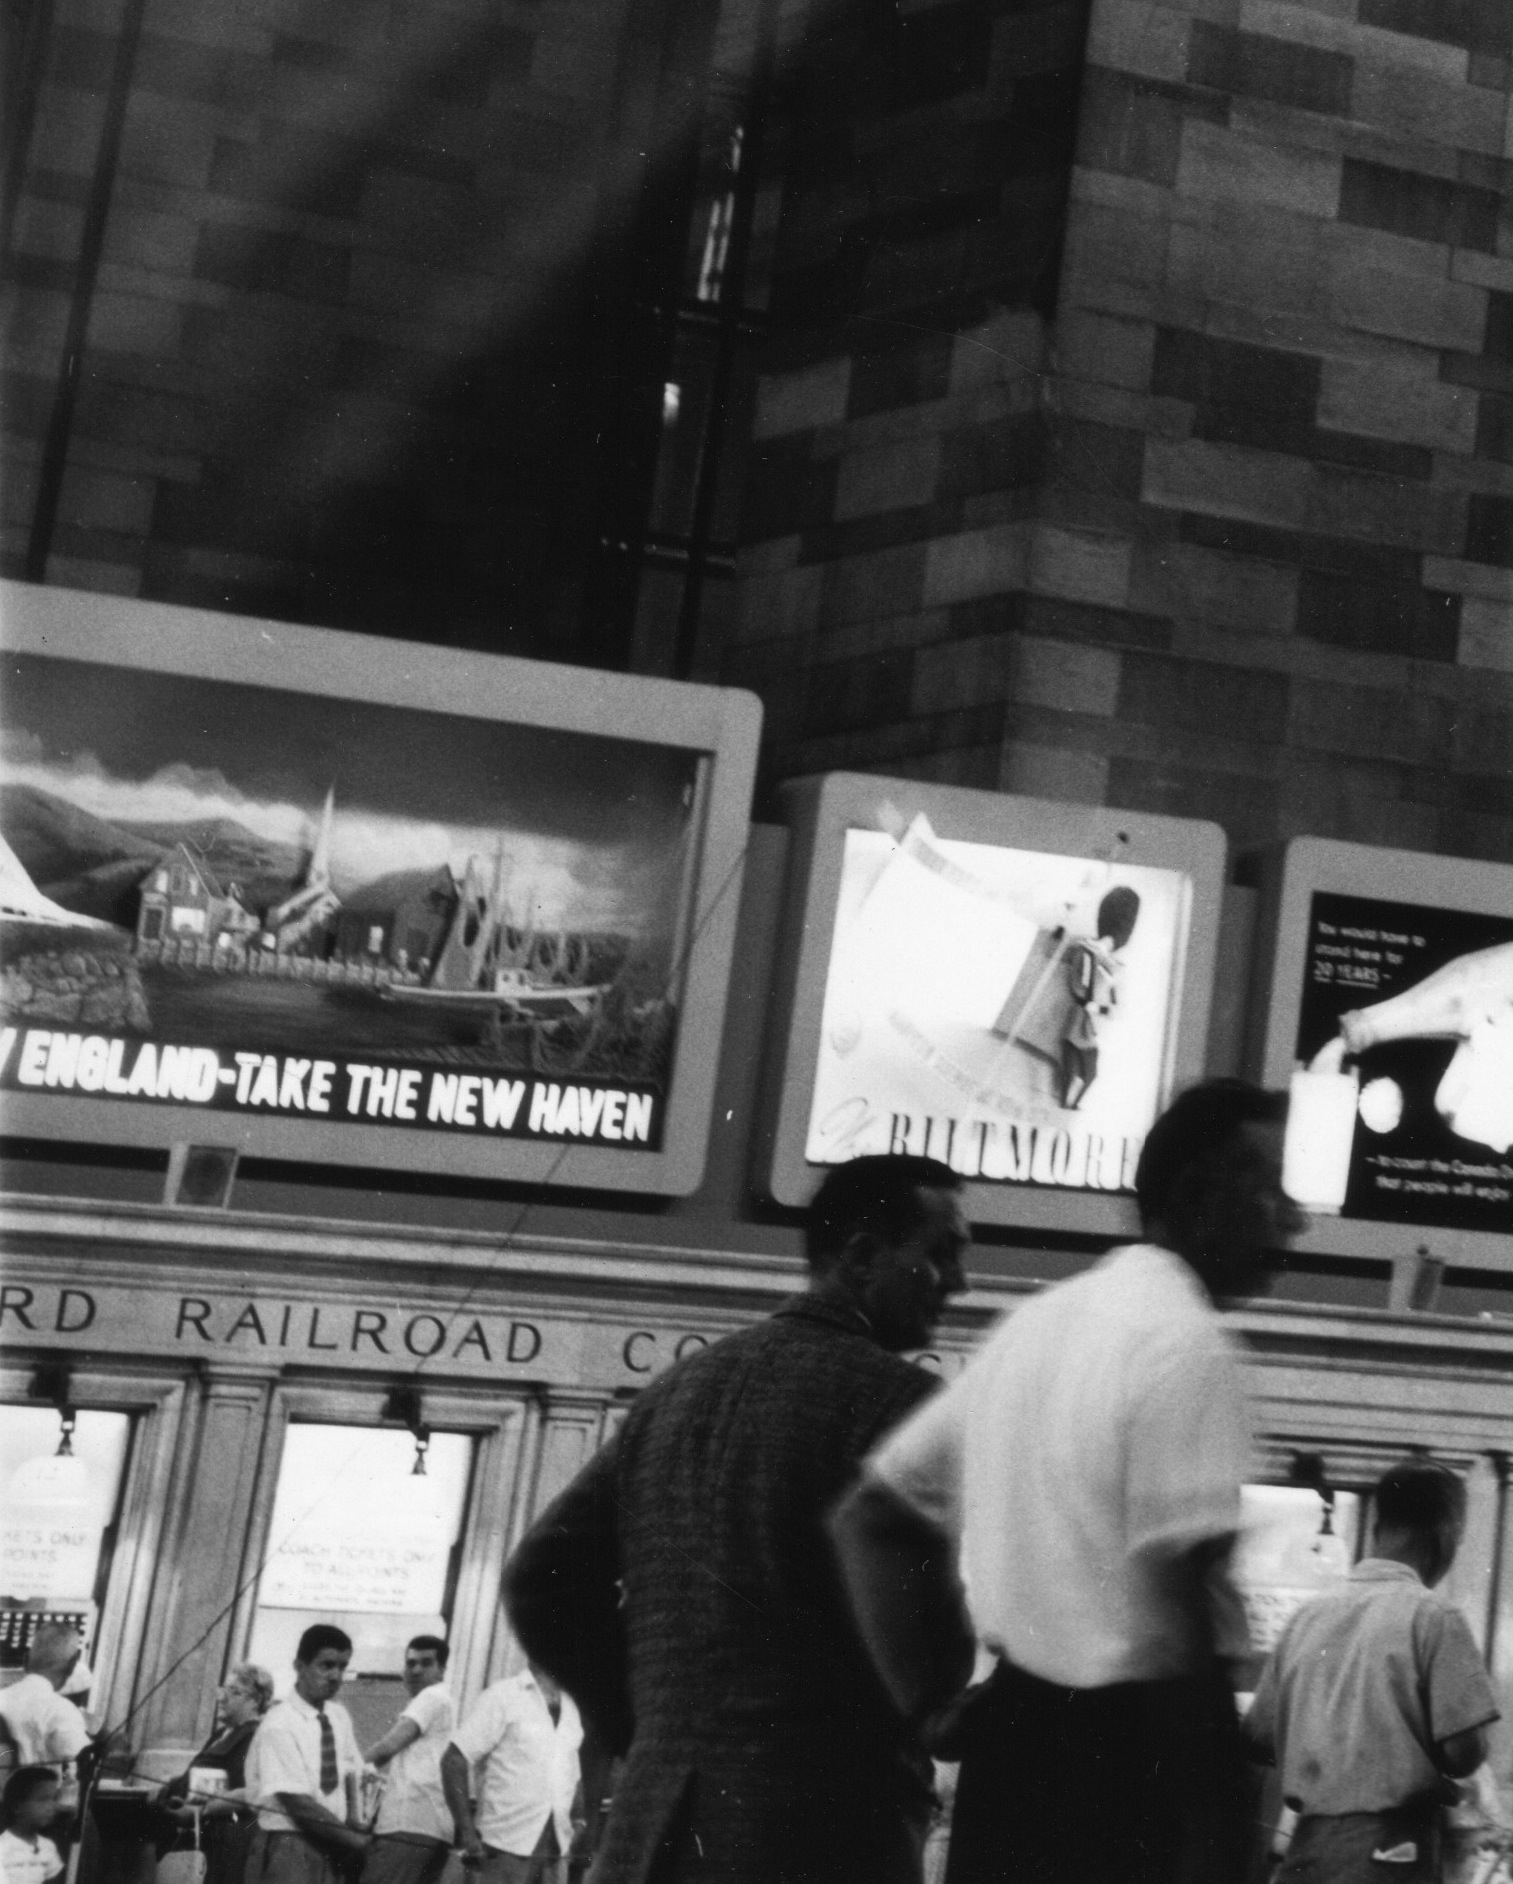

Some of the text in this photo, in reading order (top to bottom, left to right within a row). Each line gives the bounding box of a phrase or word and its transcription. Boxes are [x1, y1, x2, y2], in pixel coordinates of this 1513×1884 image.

[345, 1063, 423, 1119] THE
[427, 1073, 526, 1130] NEW
[528, 1083, 654, 1143] HAVEN
[175, 1299, 541, 1365] RAILROAD
